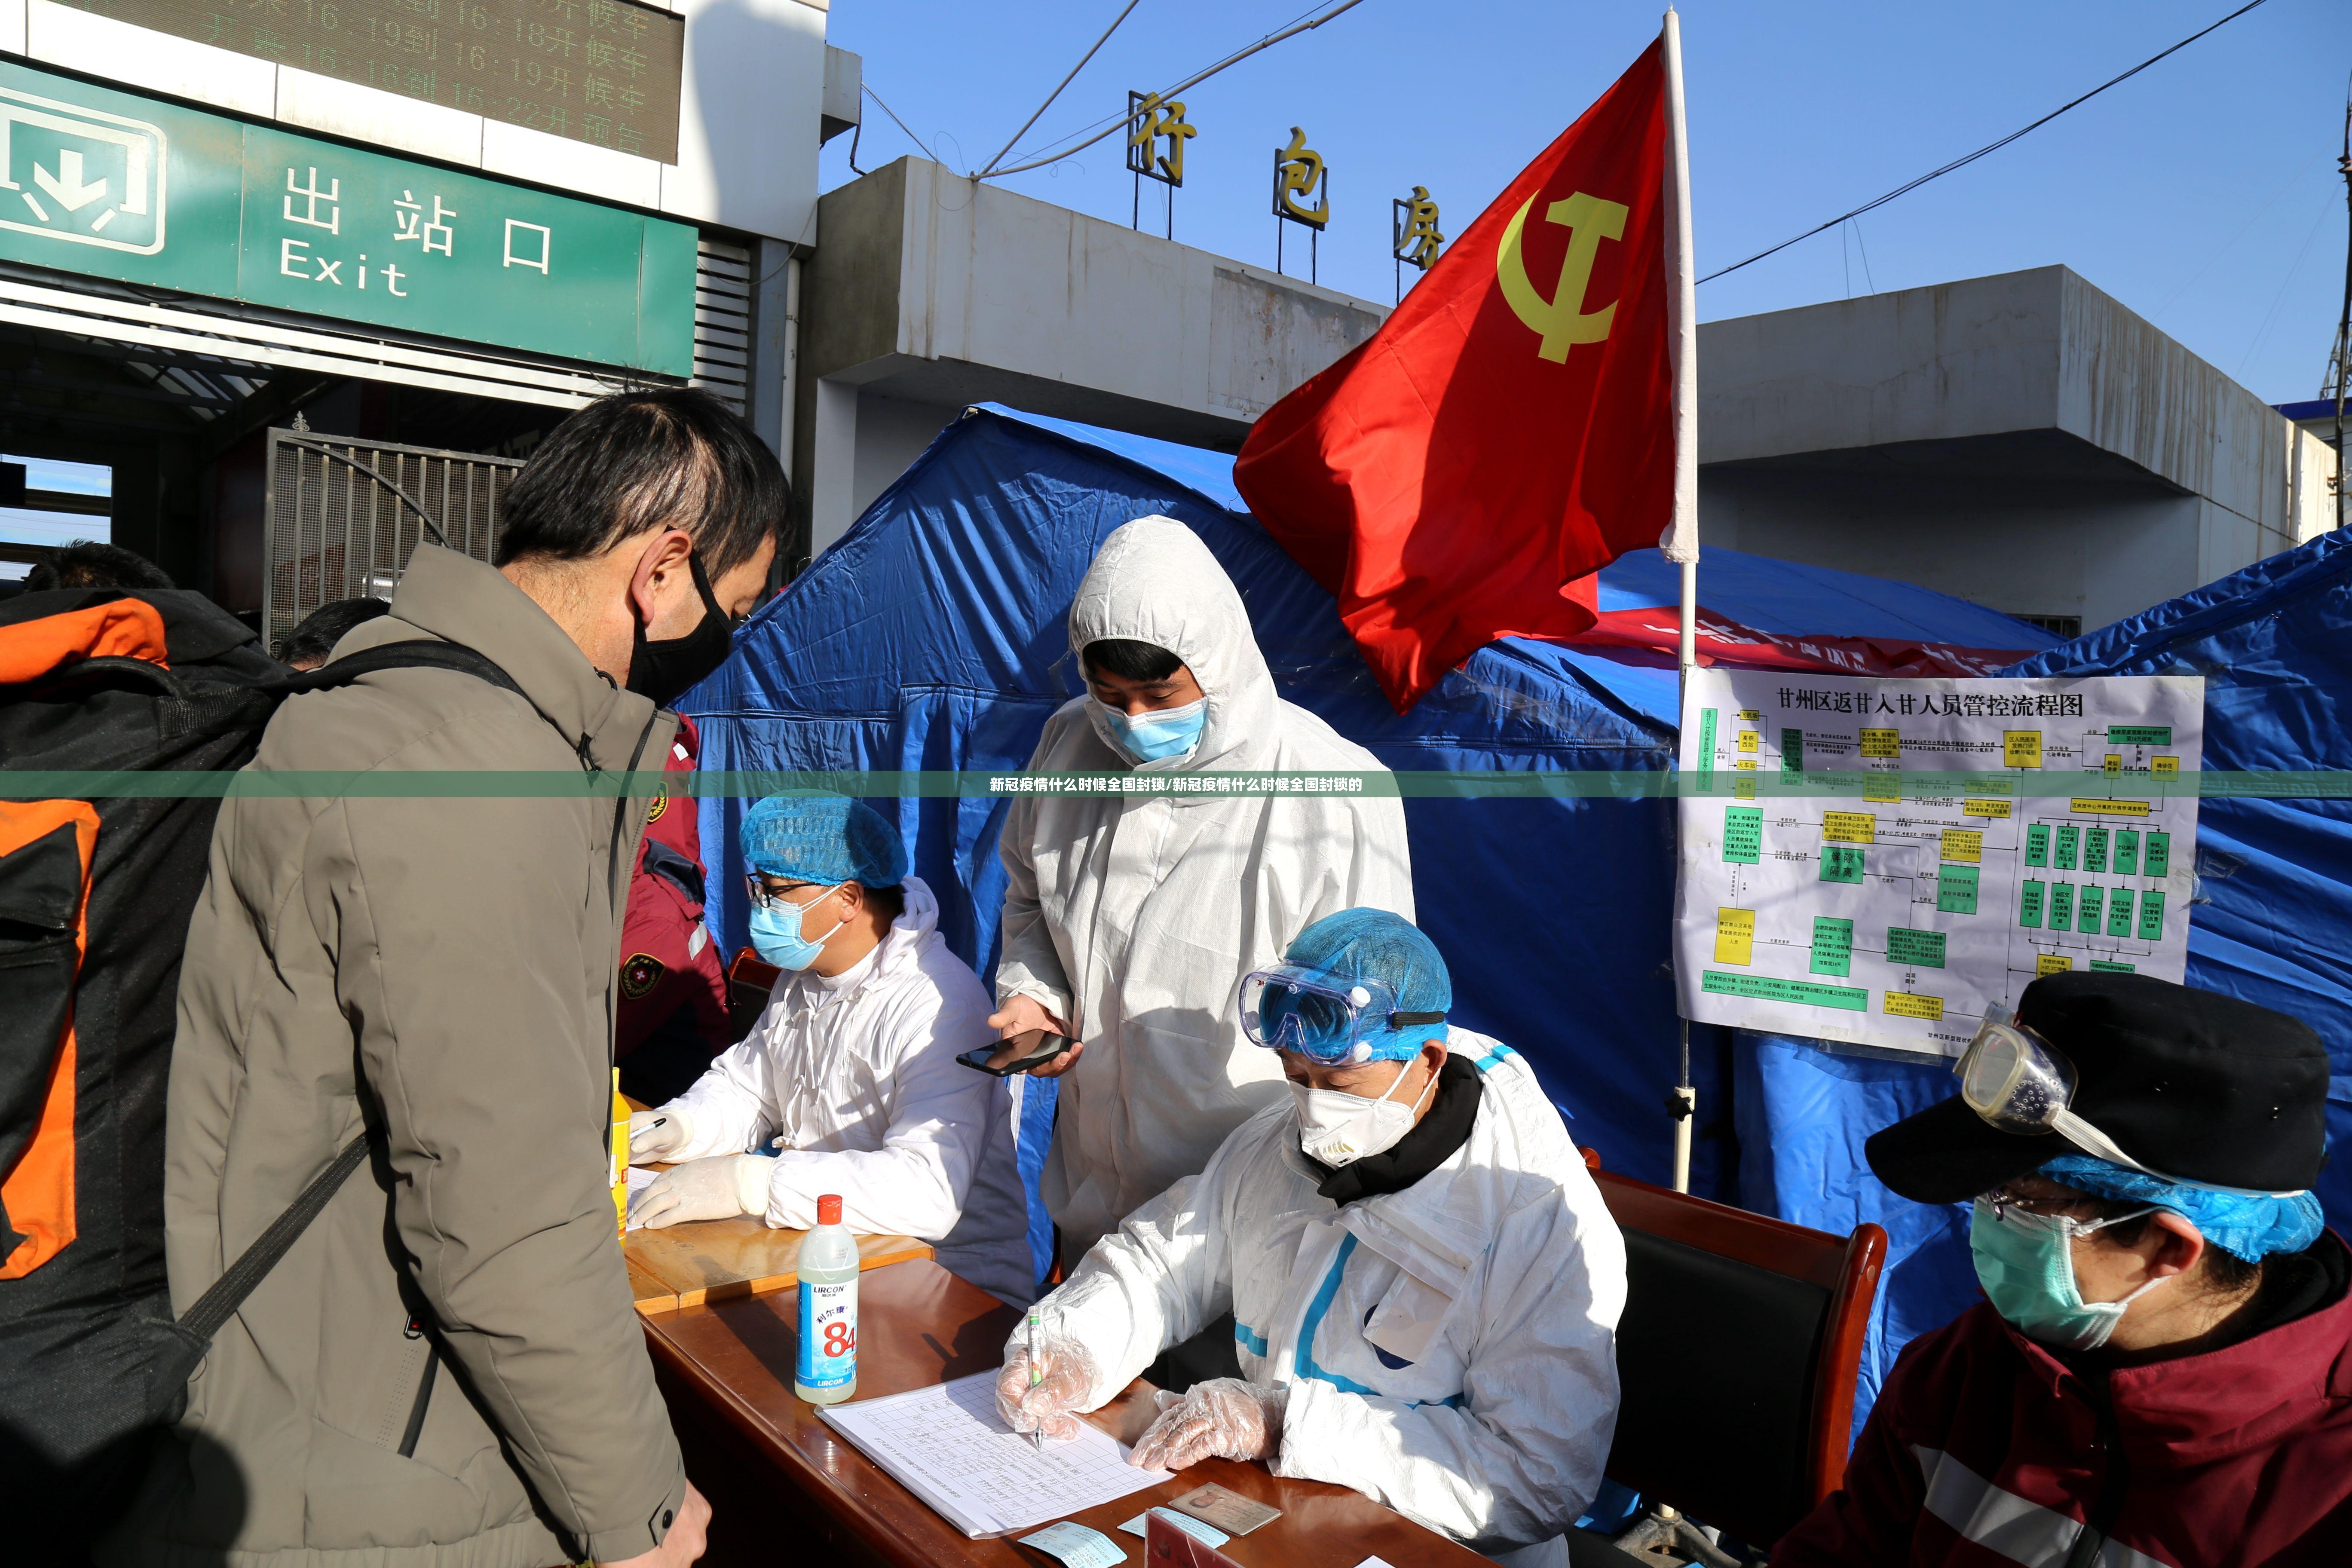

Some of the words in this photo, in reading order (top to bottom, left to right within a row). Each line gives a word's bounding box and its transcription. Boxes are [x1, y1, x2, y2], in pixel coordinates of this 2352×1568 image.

[586, 34, 648, 78] 候车
[584, 72, 646, 116] 候车
[581, 111, 645, 155] 预告
[1129, 92, 1445, 270] 行包房
[283, 166, 550, 275] 出站口
[281, 238, 407, 297] Exit
[1776, 687, 2084, 717] 甘州区返甘入甘人员管控流程图
[1830, 851, 1853, 864] 解除
[1830, 866, 1853, 878] 隔离
[813, 1285, 844, 1293] LIRCON
[816, 1306, 845, 1324] 利尔康
[824, 1322, 855, 1357] 84
[817, 1377, 843, 1387] LIRCON
